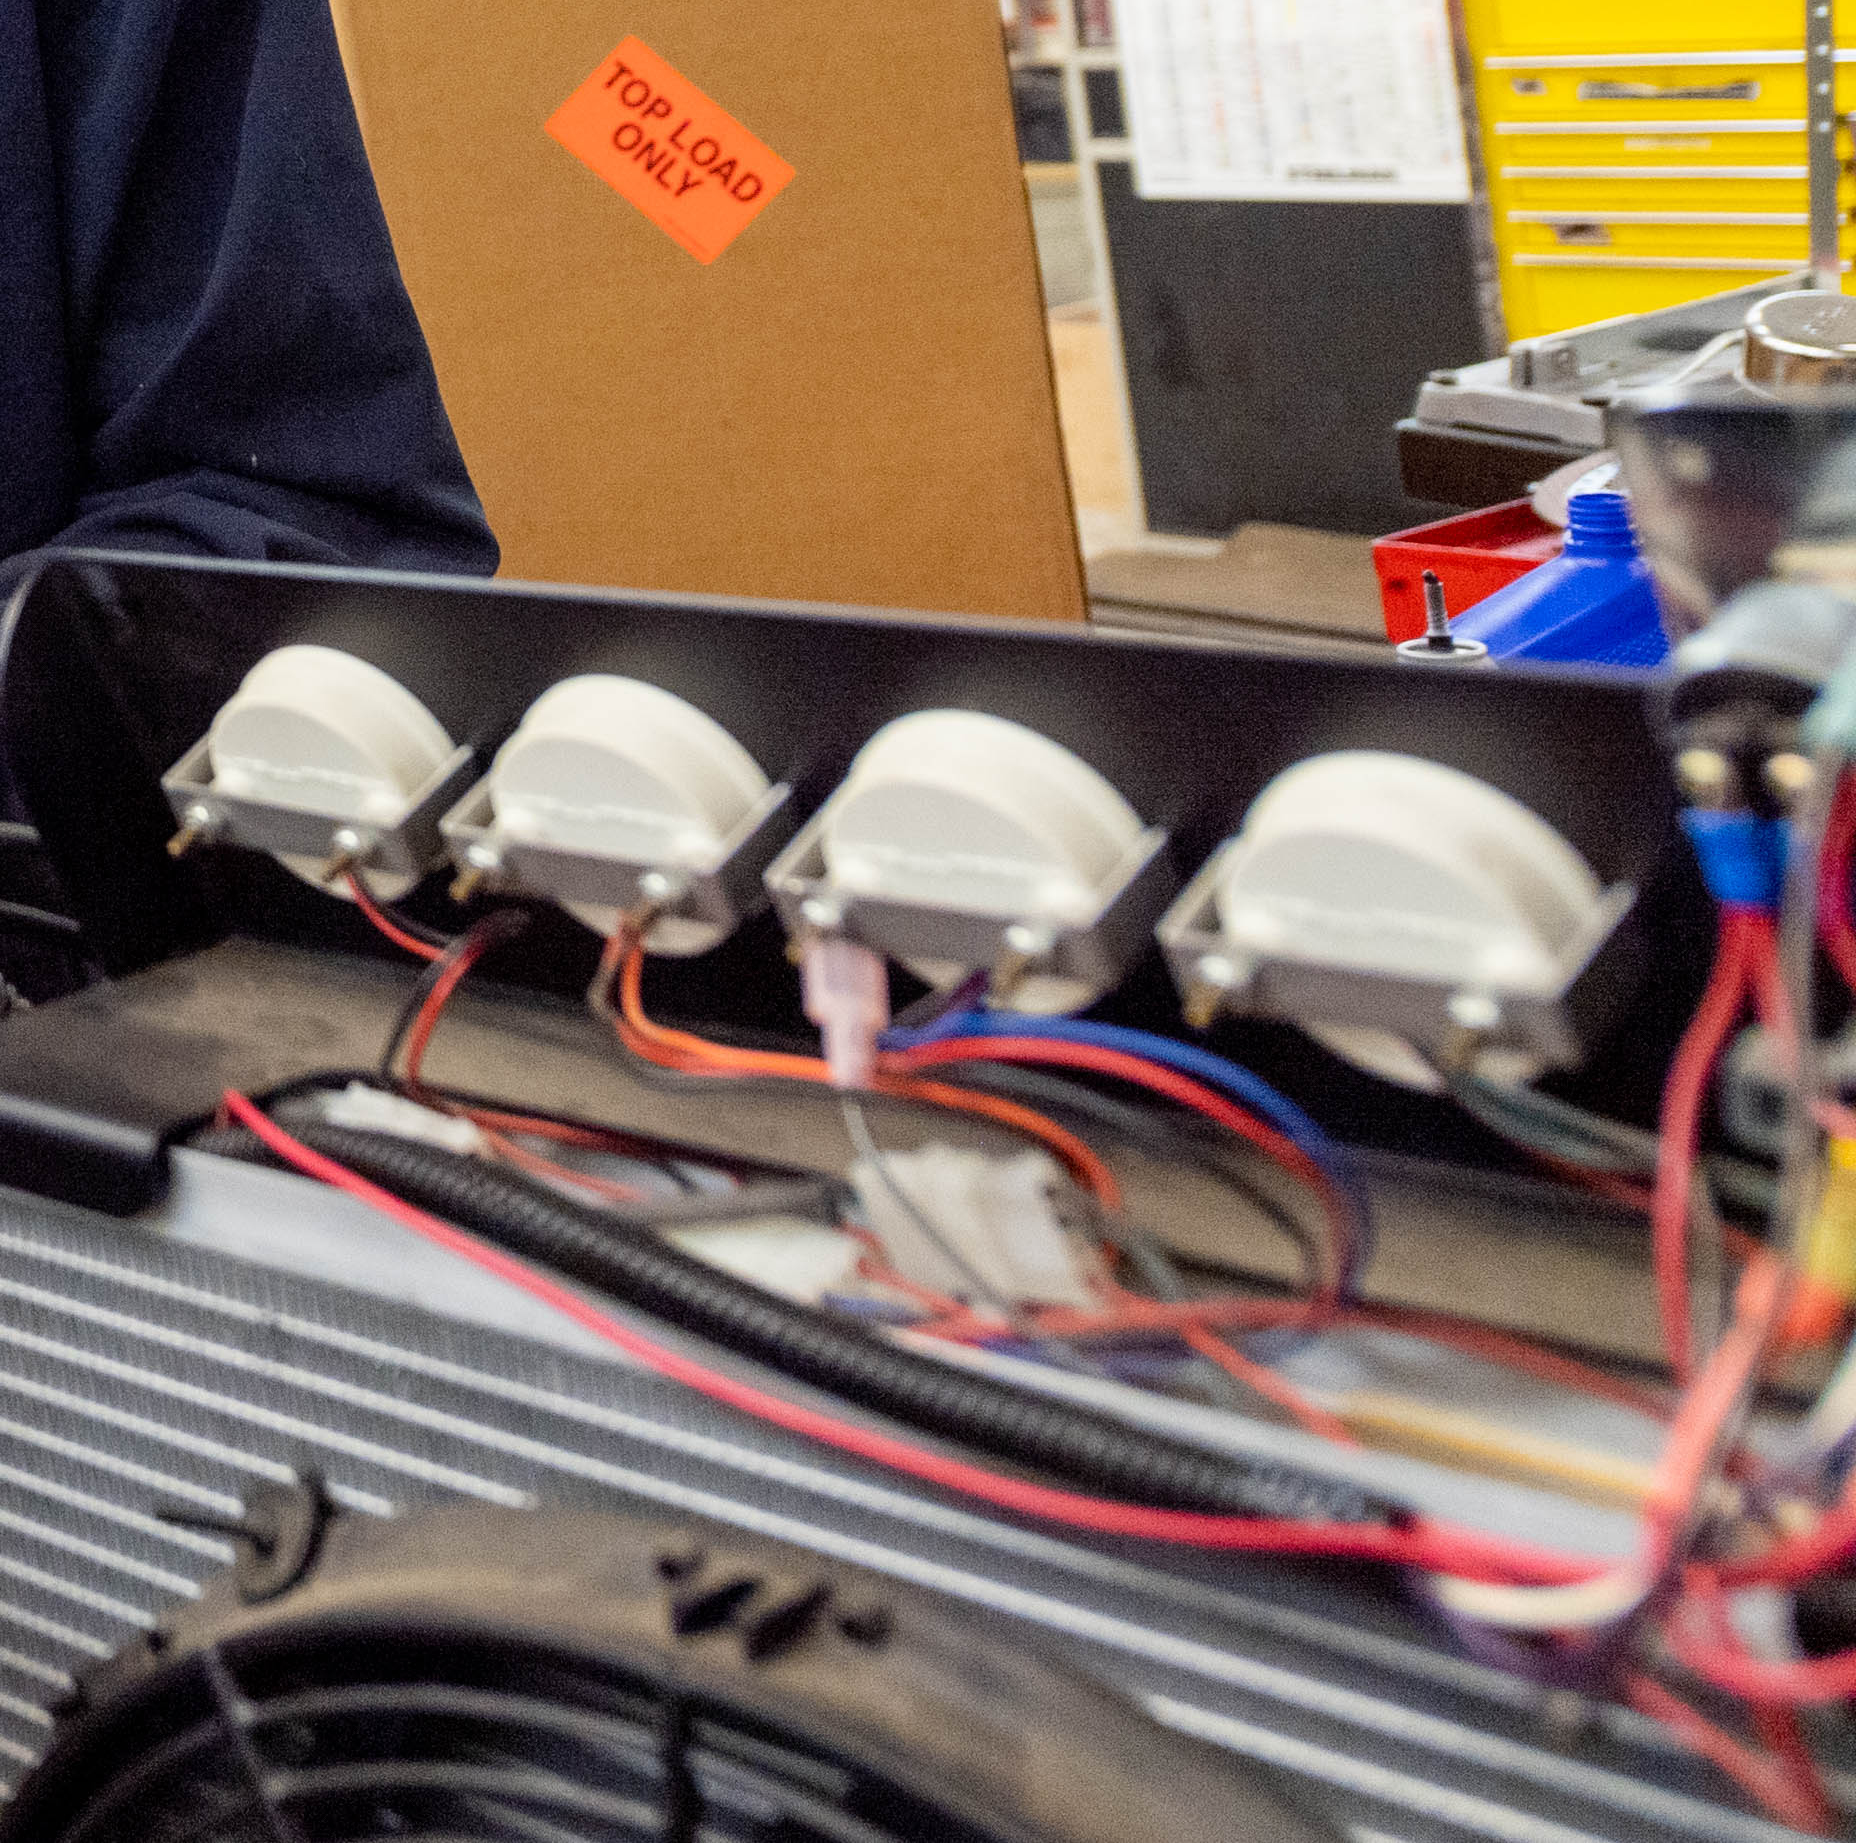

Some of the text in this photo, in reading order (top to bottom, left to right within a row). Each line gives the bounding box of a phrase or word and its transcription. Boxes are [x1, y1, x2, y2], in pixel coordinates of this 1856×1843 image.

[604, 60, 763, 202] TOP LOAD
[613, 123, 702, 198] ONLY
